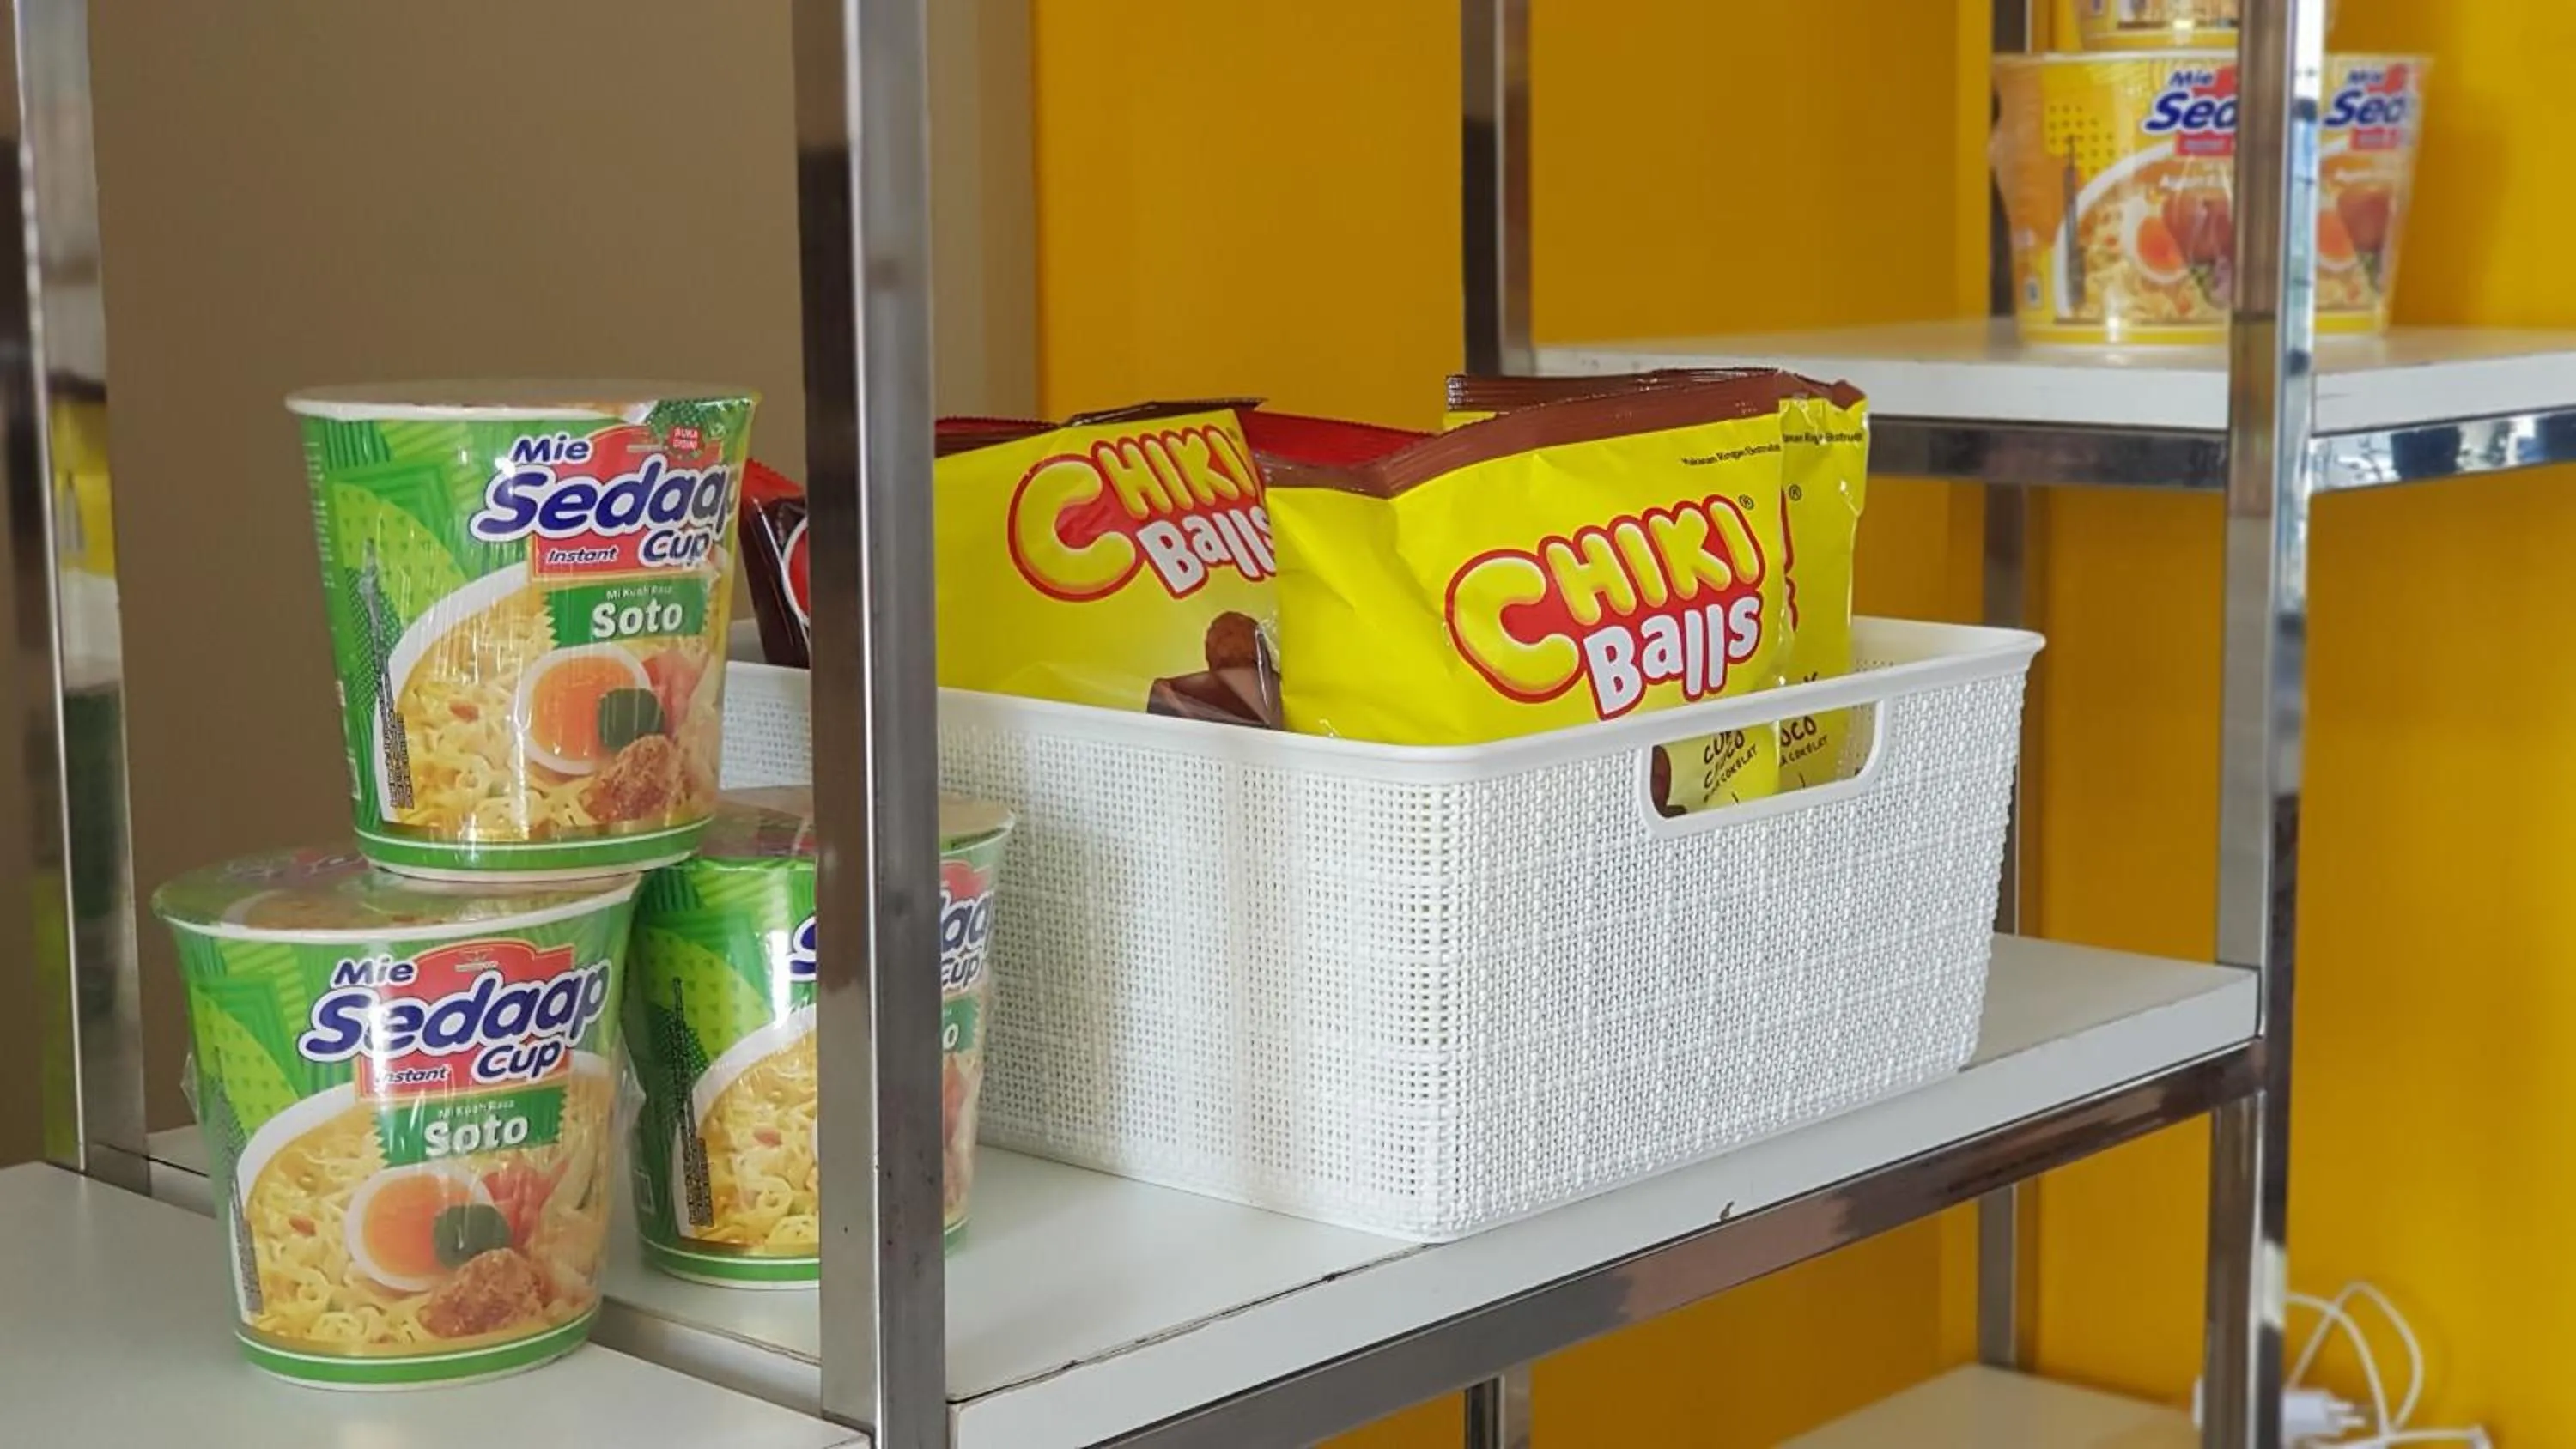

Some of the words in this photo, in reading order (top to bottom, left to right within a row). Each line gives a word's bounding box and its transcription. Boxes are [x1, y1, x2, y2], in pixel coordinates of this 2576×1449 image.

[514, 437, 591, 463] Mie
[1012, 426, 1261, 597] CHIKI
[546, 547, 617, 563] Instant
[643, 529, 710, 566] Cup
[1453, 499, 1762, 698] CHIKI
[592, 598, 683, 639] Soto
[1583, 596, 1763, 716] Balls
[336, 961, 414, 985] Mie
[302, 965, 610, 1055] Sedaap
[374, 1066, 448, 1082] nstant
[477, 1042, 561, 1079] Cup
[424, 1114, 529, 1155] Soto
